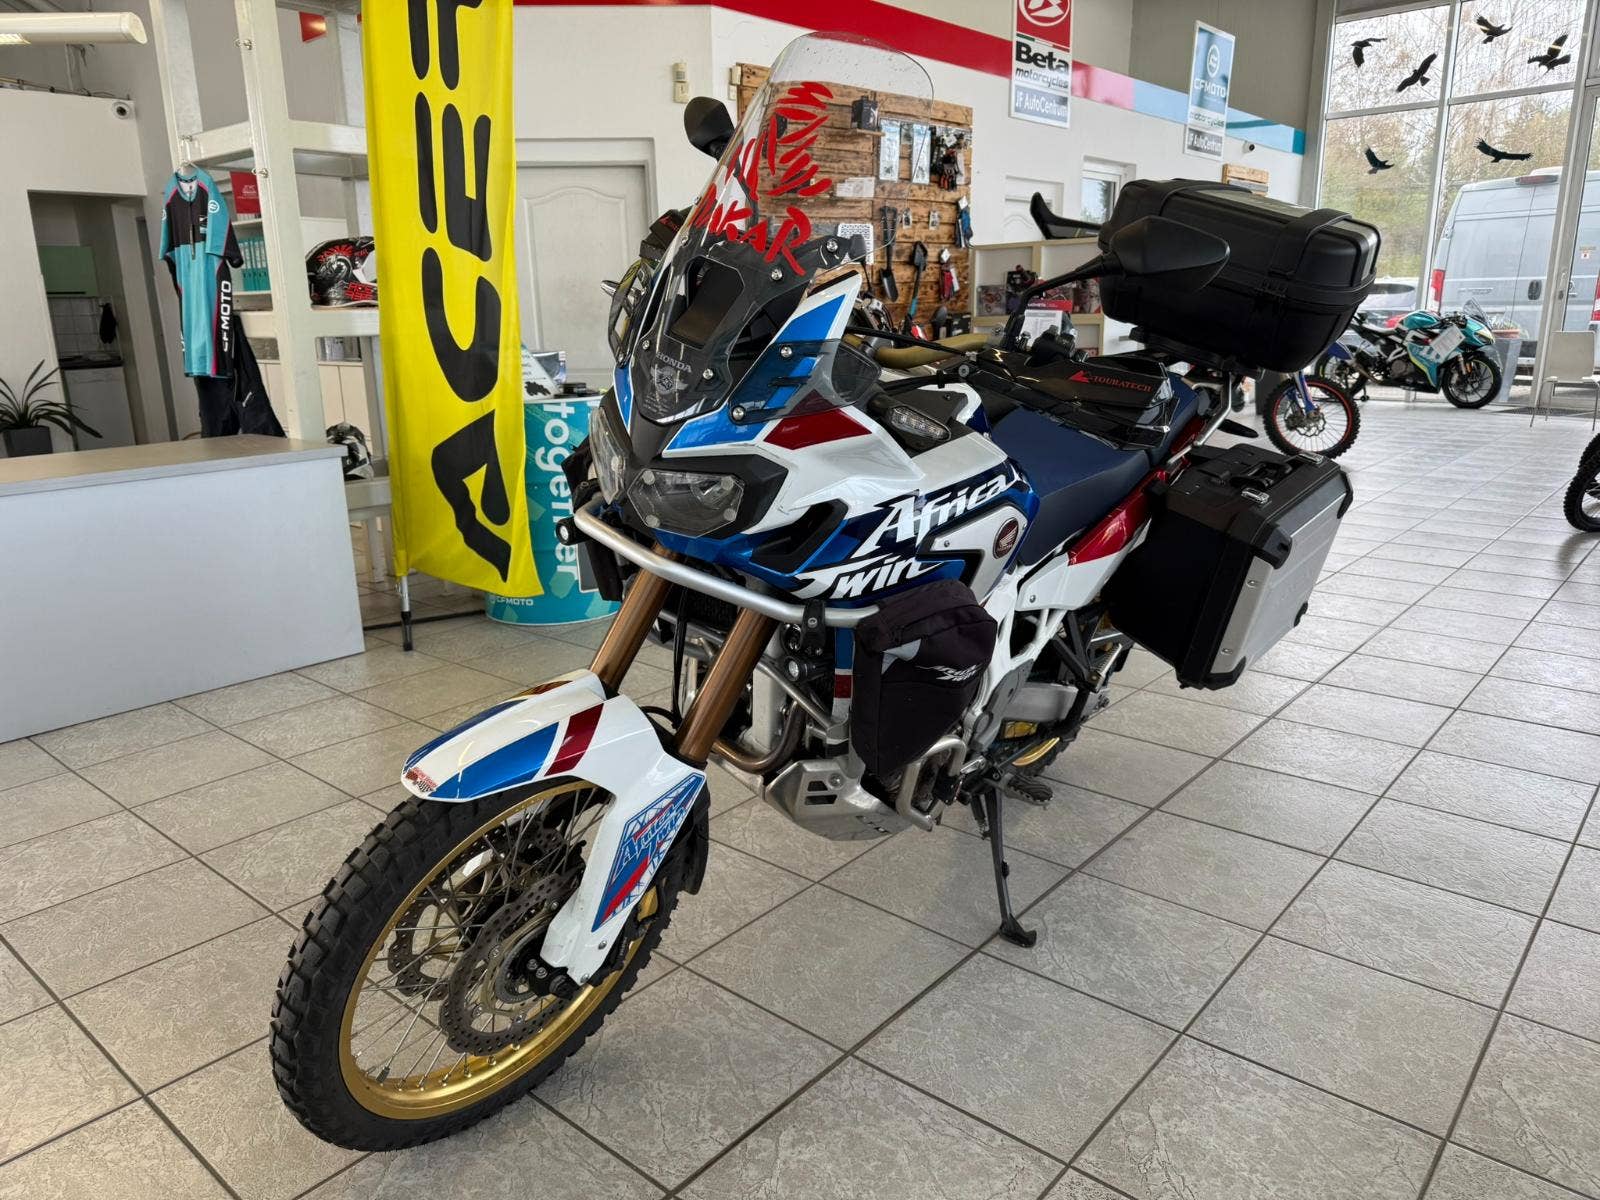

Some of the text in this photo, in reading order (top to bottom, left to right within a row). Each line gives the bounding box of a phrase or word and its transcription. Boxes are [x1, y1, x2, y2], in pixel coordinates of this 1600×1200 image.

[1016, 40, 1069, 75] Beta
[1016, 67, 1069, 89] motorcycles
[1194, 78, 1226, 98] CFMOTO
[655, 351, 692, 373] HONDA
[1092, 375, 1153, 393] TOURATECH
[850, 473, 1014, 559] Africa
[790, 553, 945, 600] Twin
